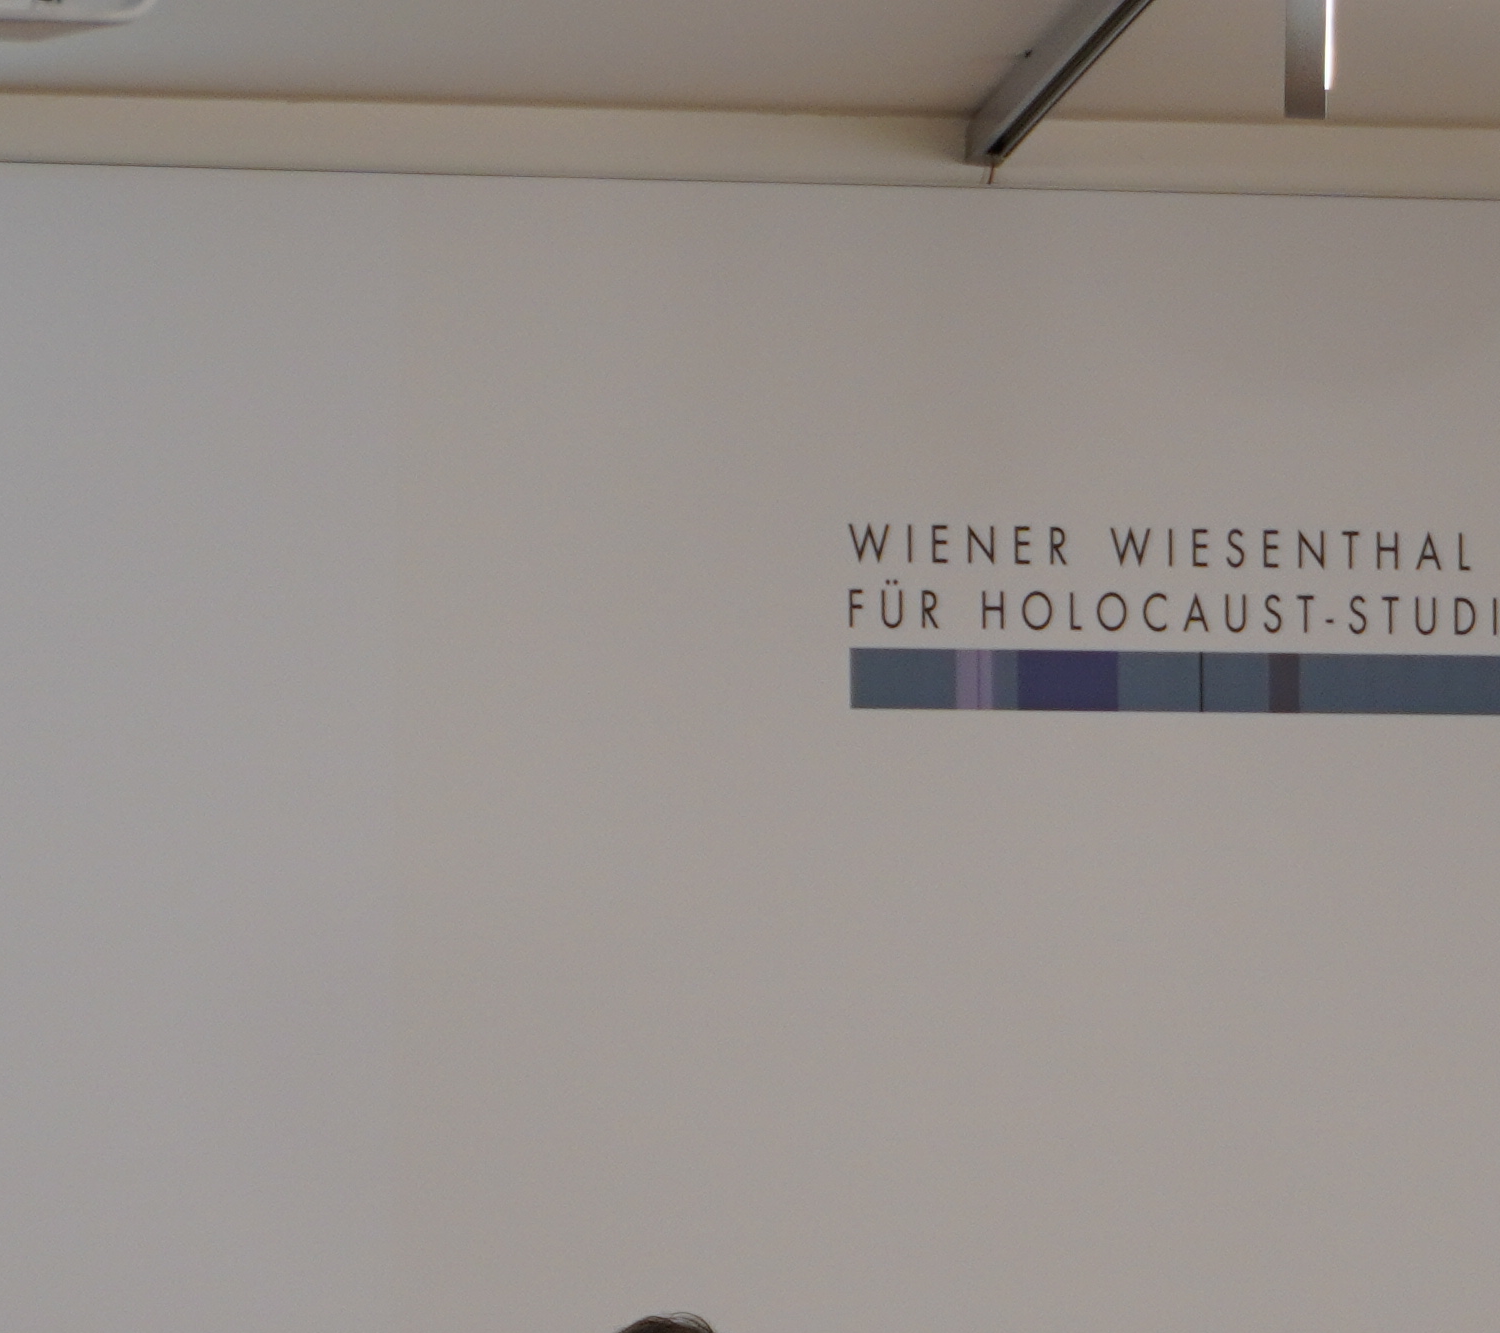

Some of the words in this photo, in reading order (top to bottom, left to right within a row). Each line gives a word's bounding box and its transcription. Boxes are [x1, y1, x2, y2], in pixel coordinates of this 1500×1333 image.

[849, 523, 1070, 566] WIENER
[1111, 527, 1472, 572] WIESENTHAL
[849, 579, 941, 631] FÜR
